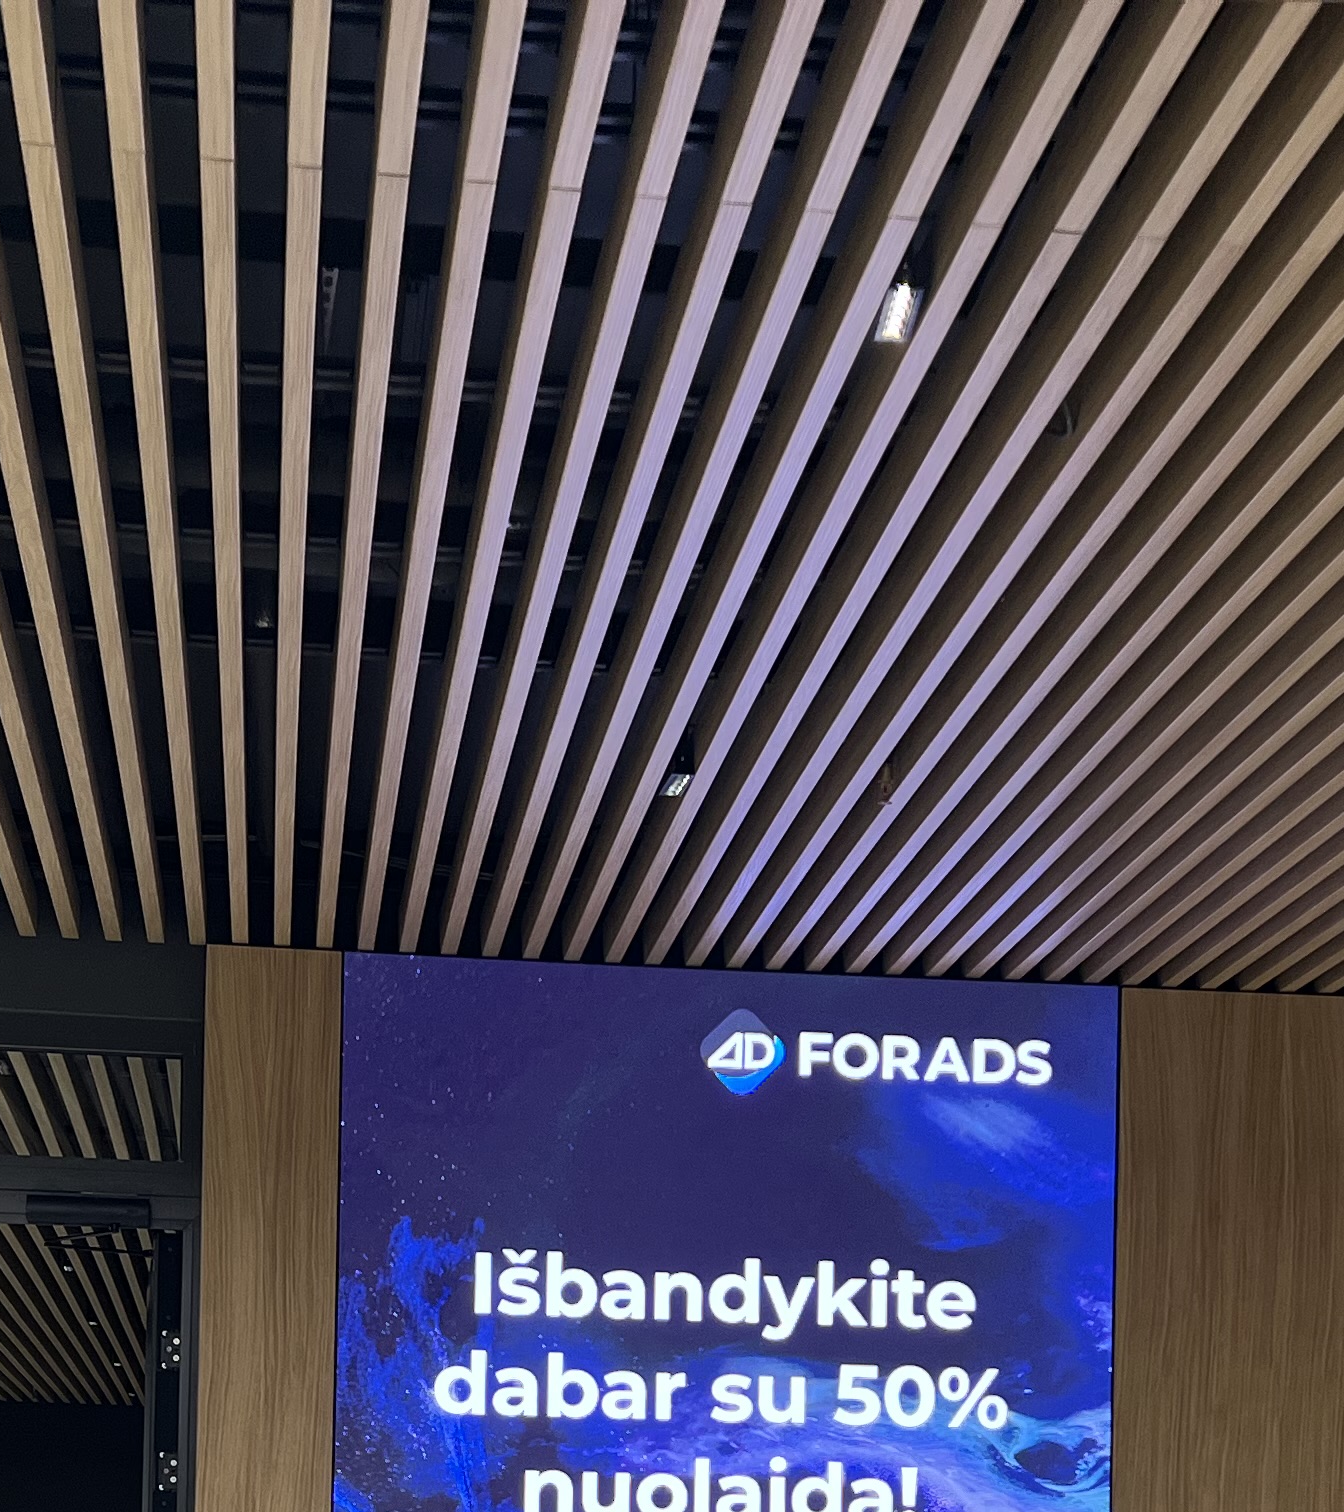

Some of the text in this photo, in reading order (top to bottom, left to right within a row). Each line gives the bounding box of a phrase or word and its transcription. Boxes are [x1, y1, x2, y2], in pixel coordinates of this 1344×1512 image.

[798, 1031, 1053, 1086] FORADS
[473, 1248, 976, 1341] Išbandykite
[432, 1350, 1008, 1430] dabar su 50%
